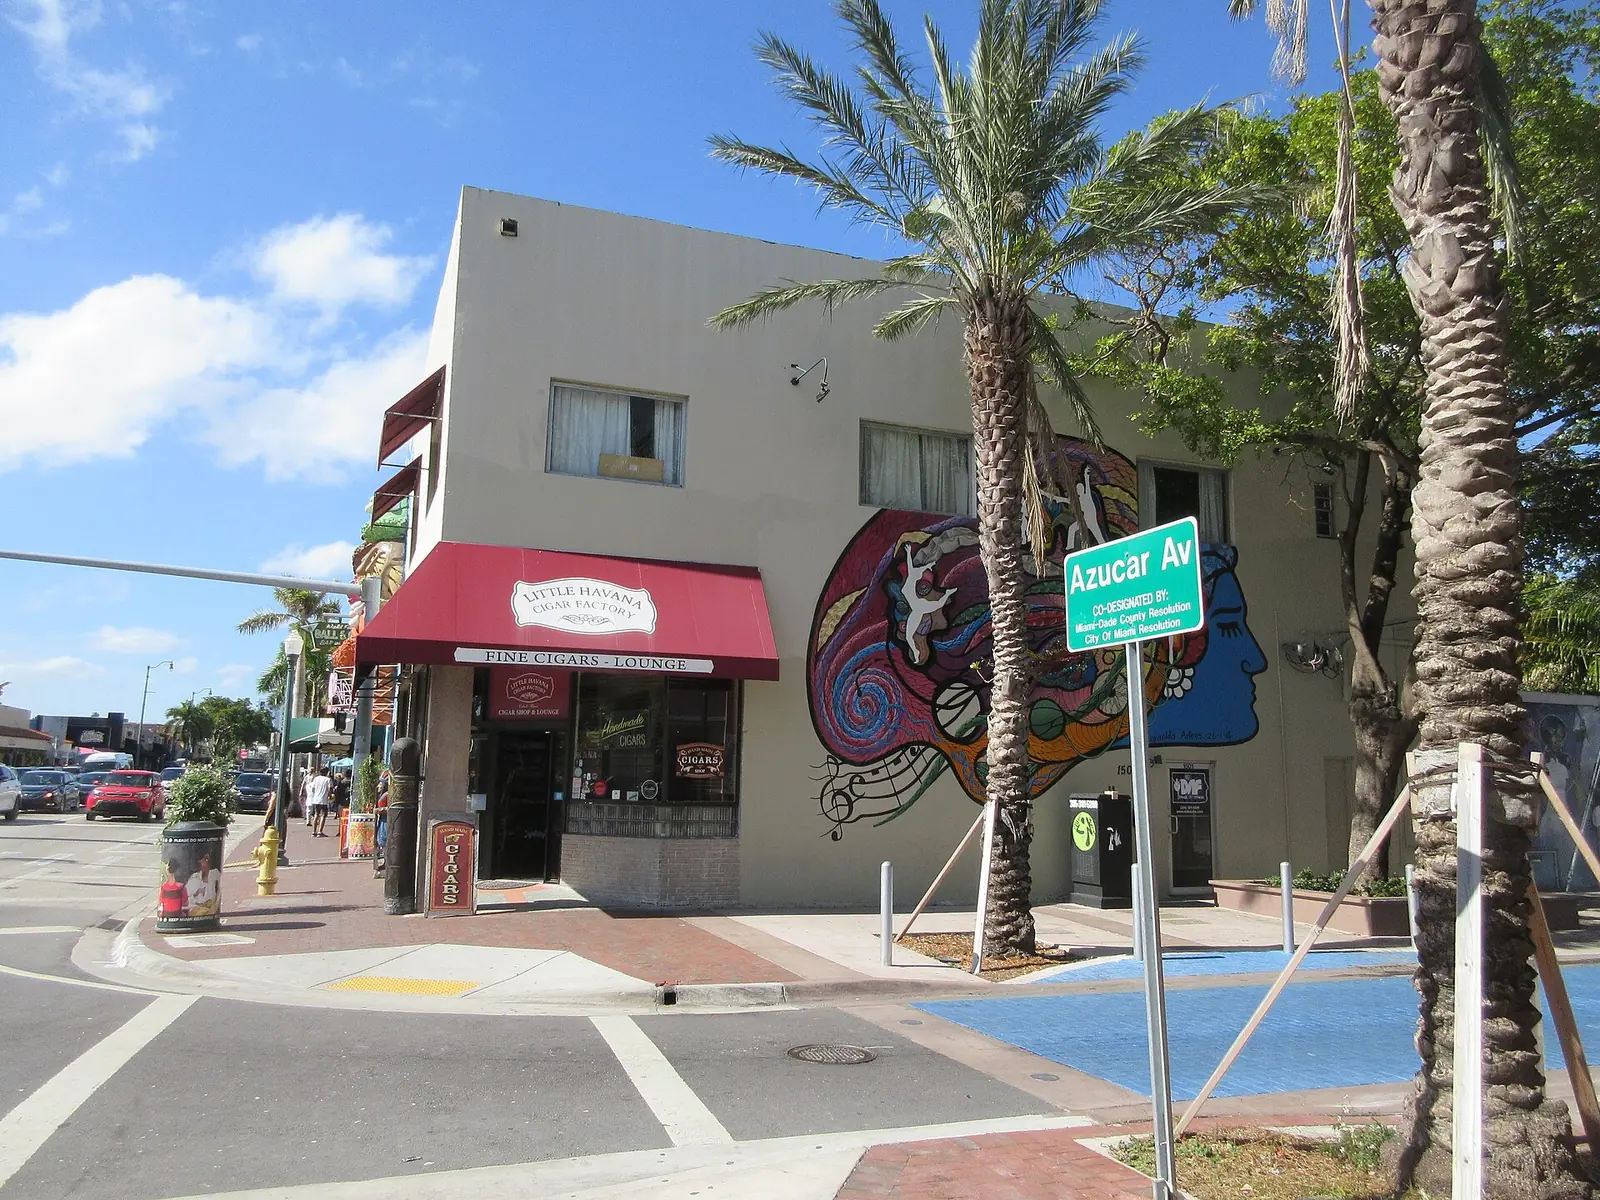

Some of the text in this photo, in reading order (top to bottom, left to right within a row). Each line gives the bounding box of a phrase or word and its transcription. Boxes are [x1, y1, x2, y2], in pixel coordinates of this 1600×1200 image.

[1069, 536, 1191, 595] Azucar Av
[523, 586, 643, 610] LITTLE HAVANA
[1092, 589, 1169, 617] CO-DESIGNATED BY:
[532, 600, 636, 620] CIGAR FACTORY
[1075, 601, 1191, 634] Miami-Dade County Resolution
[314, 628, 338, 640] BALL
[1084, 618, 1181, 645] City Of Miami Resolution
[485, 651, 529, 663] FINE
[534, 652, 599, 666] CIGARS
[614, 657, 687, 671] LOUNGE
[510, 678, 549, 690] LITTLE HAVANA
[536, 708, 560, 716] LOUNGE
[601, 713, 645, 738] Handmade
[620, 733, 646, 747] CIGARS
[681, 756, 719, 764] CIGARS
[442, 844, 460, 905] CIGARS
